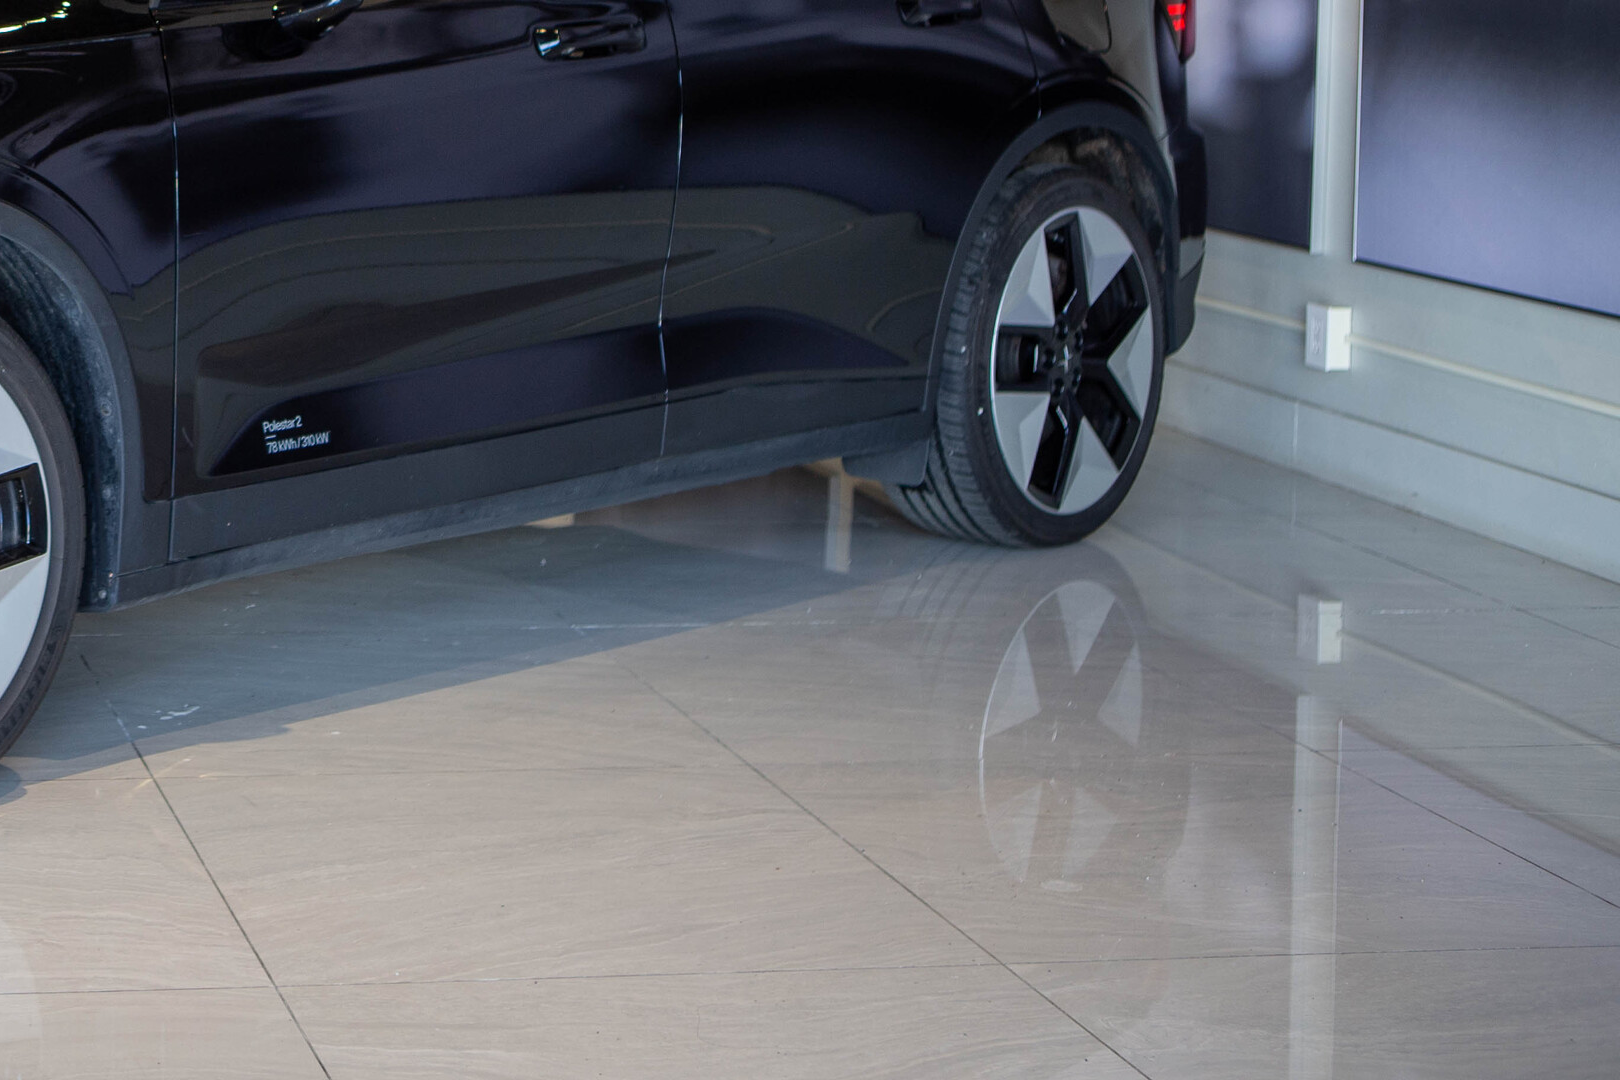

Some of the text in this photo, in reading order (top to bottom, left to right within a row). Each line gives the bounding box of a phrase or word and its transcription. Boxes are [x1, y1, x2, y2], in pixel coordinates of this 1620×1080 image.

[262, 415, 303, 434] Polestar 2
[266, 440, 279, 454] 78
[278, 436, 297, 452] kWh
[300, 433, 315, 448] 310
[314, 430, 331, 446] kW
